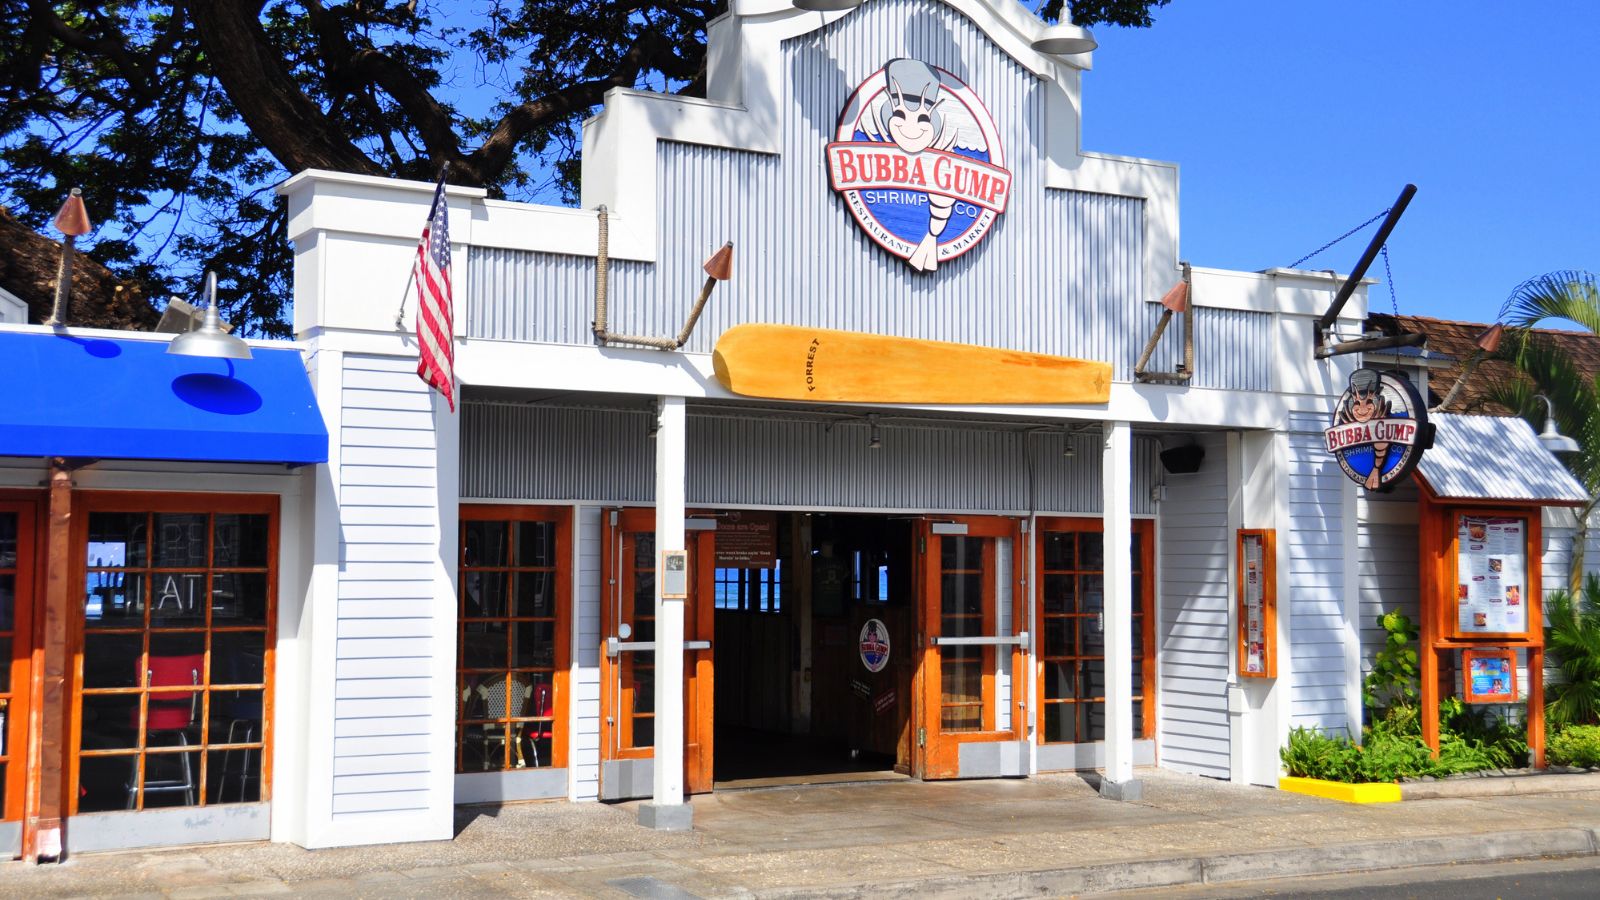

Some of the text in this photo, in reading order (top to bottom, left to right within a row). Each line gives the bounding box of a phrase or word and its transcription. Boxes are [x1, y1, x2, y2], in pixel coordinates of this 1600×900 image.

[837, 149, 1006, 204] BUBBA GUMP
[865, 191, 928, 206] SHRIMP
[848, 191, 991, 256] RESTAURANT & MARKET
[805, 338, 820, 392] FORREST
[1328, 420, 1415, 450] BUBBA GUMP
[136, 575, 224, 610] LATE
